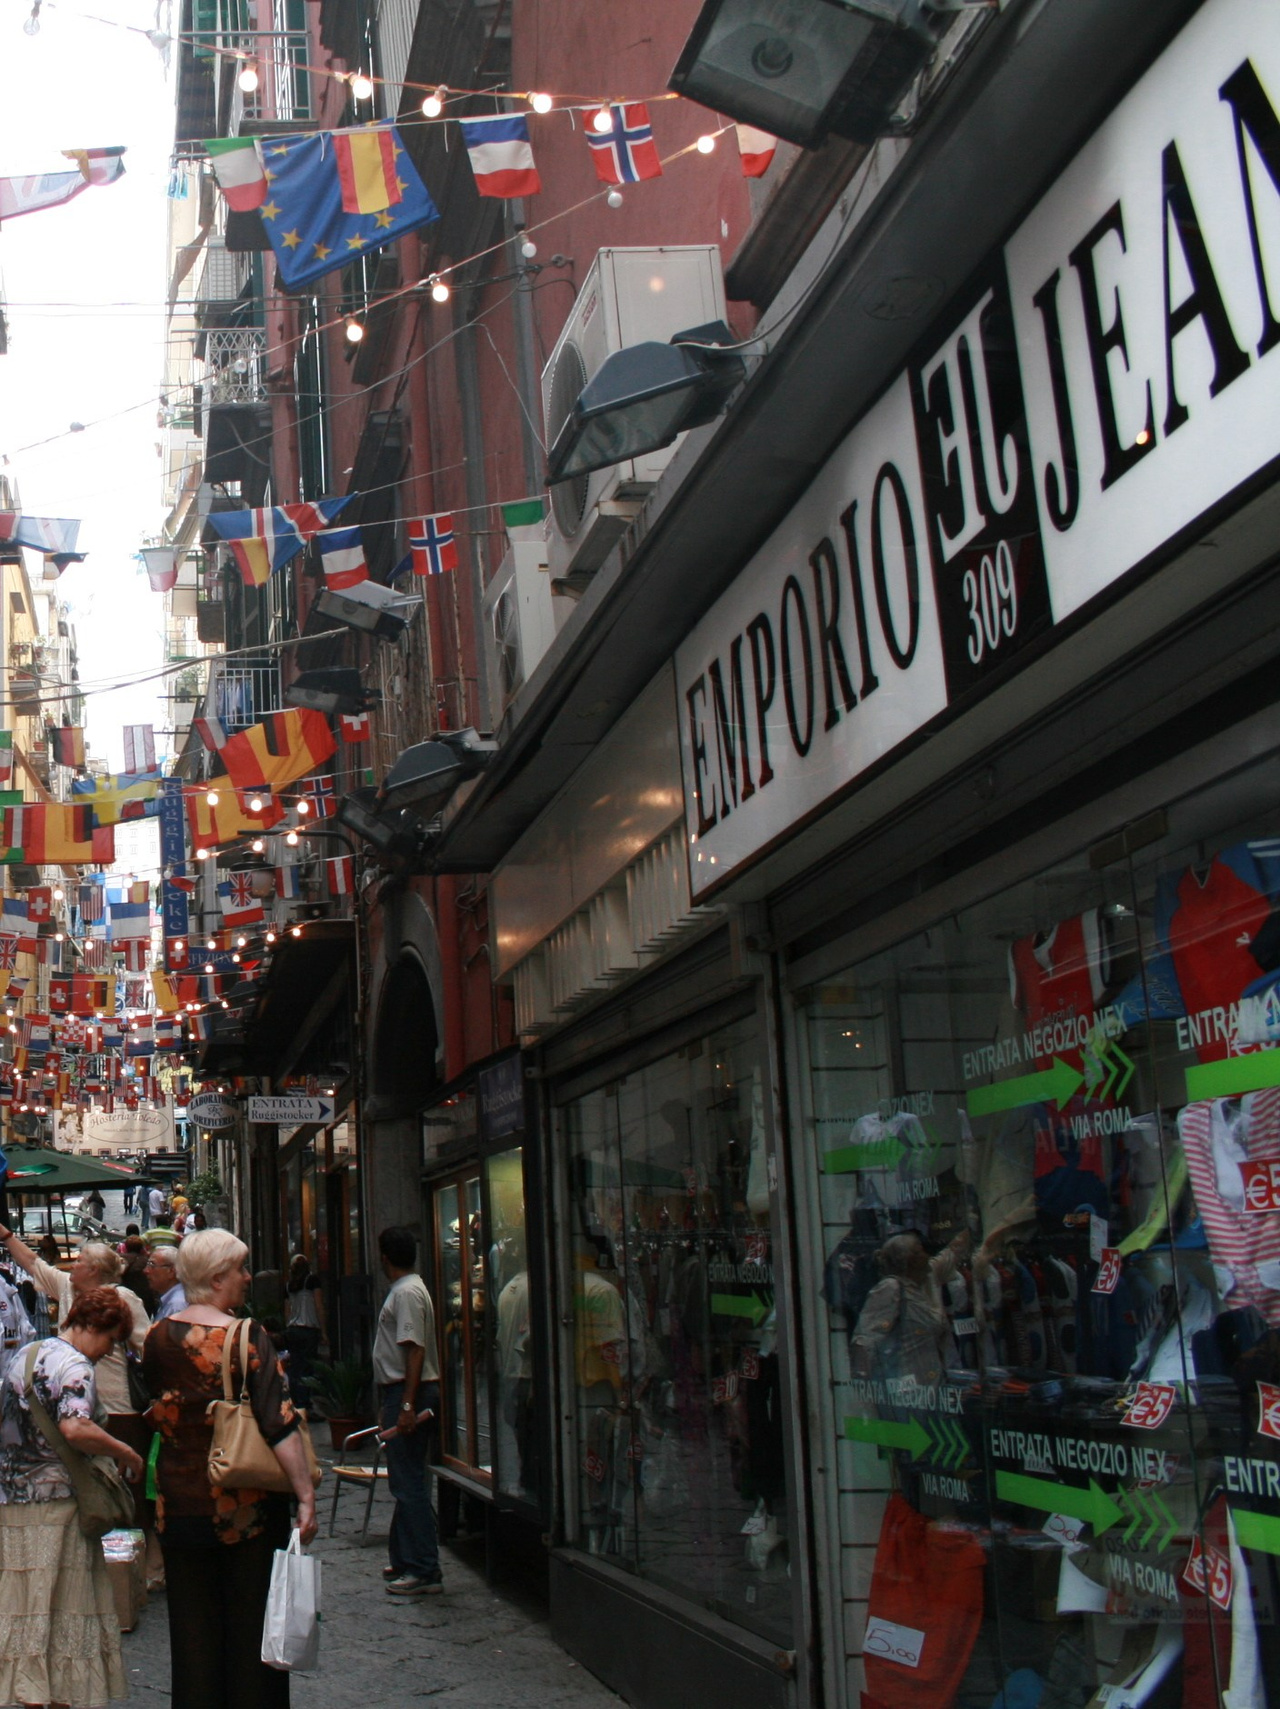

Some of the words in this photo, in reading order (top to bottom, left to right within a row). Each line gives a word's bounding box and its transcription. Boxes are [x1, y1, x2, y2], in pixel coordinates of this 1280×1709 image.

[963, 539, 1017, 664] 309
[686, 462, 920, 840] EMPORIO
[962, 1035, 1020, 1080] ENTRATA
[1022, 1014, 1090, 1061] NEGOZIO
[1093, 1002, 1128, 1038] NEX
[90, 1112, 131, 1128] Hosteria
[132, 1112, 161, 1126] Toledo
[251, 1109, 315, 1121] Ruggistocker
[252, 1099, 313, 1109] ENTRATA
[1070, 1114, 1092, 1140] VIA
[1093, 1106, 1133, 1137] ROMA
[938, 1386, 965, 1415] NEX
[1129, 1392, 1172, 1426] €5
[989, 1429, 1054, 1466] ENTRATA
[1055, 1437, 1128, 1477] NEGOZIO
[1131, 1447, 1169, 1484] NEX
[921, 1472, 939, 1496] VIA
[939, 1476, 970, 1503] ROMA
[1109, 1553, 1132, 1586] VIA
[1134, 1562, 1179, 1603] ROMA
